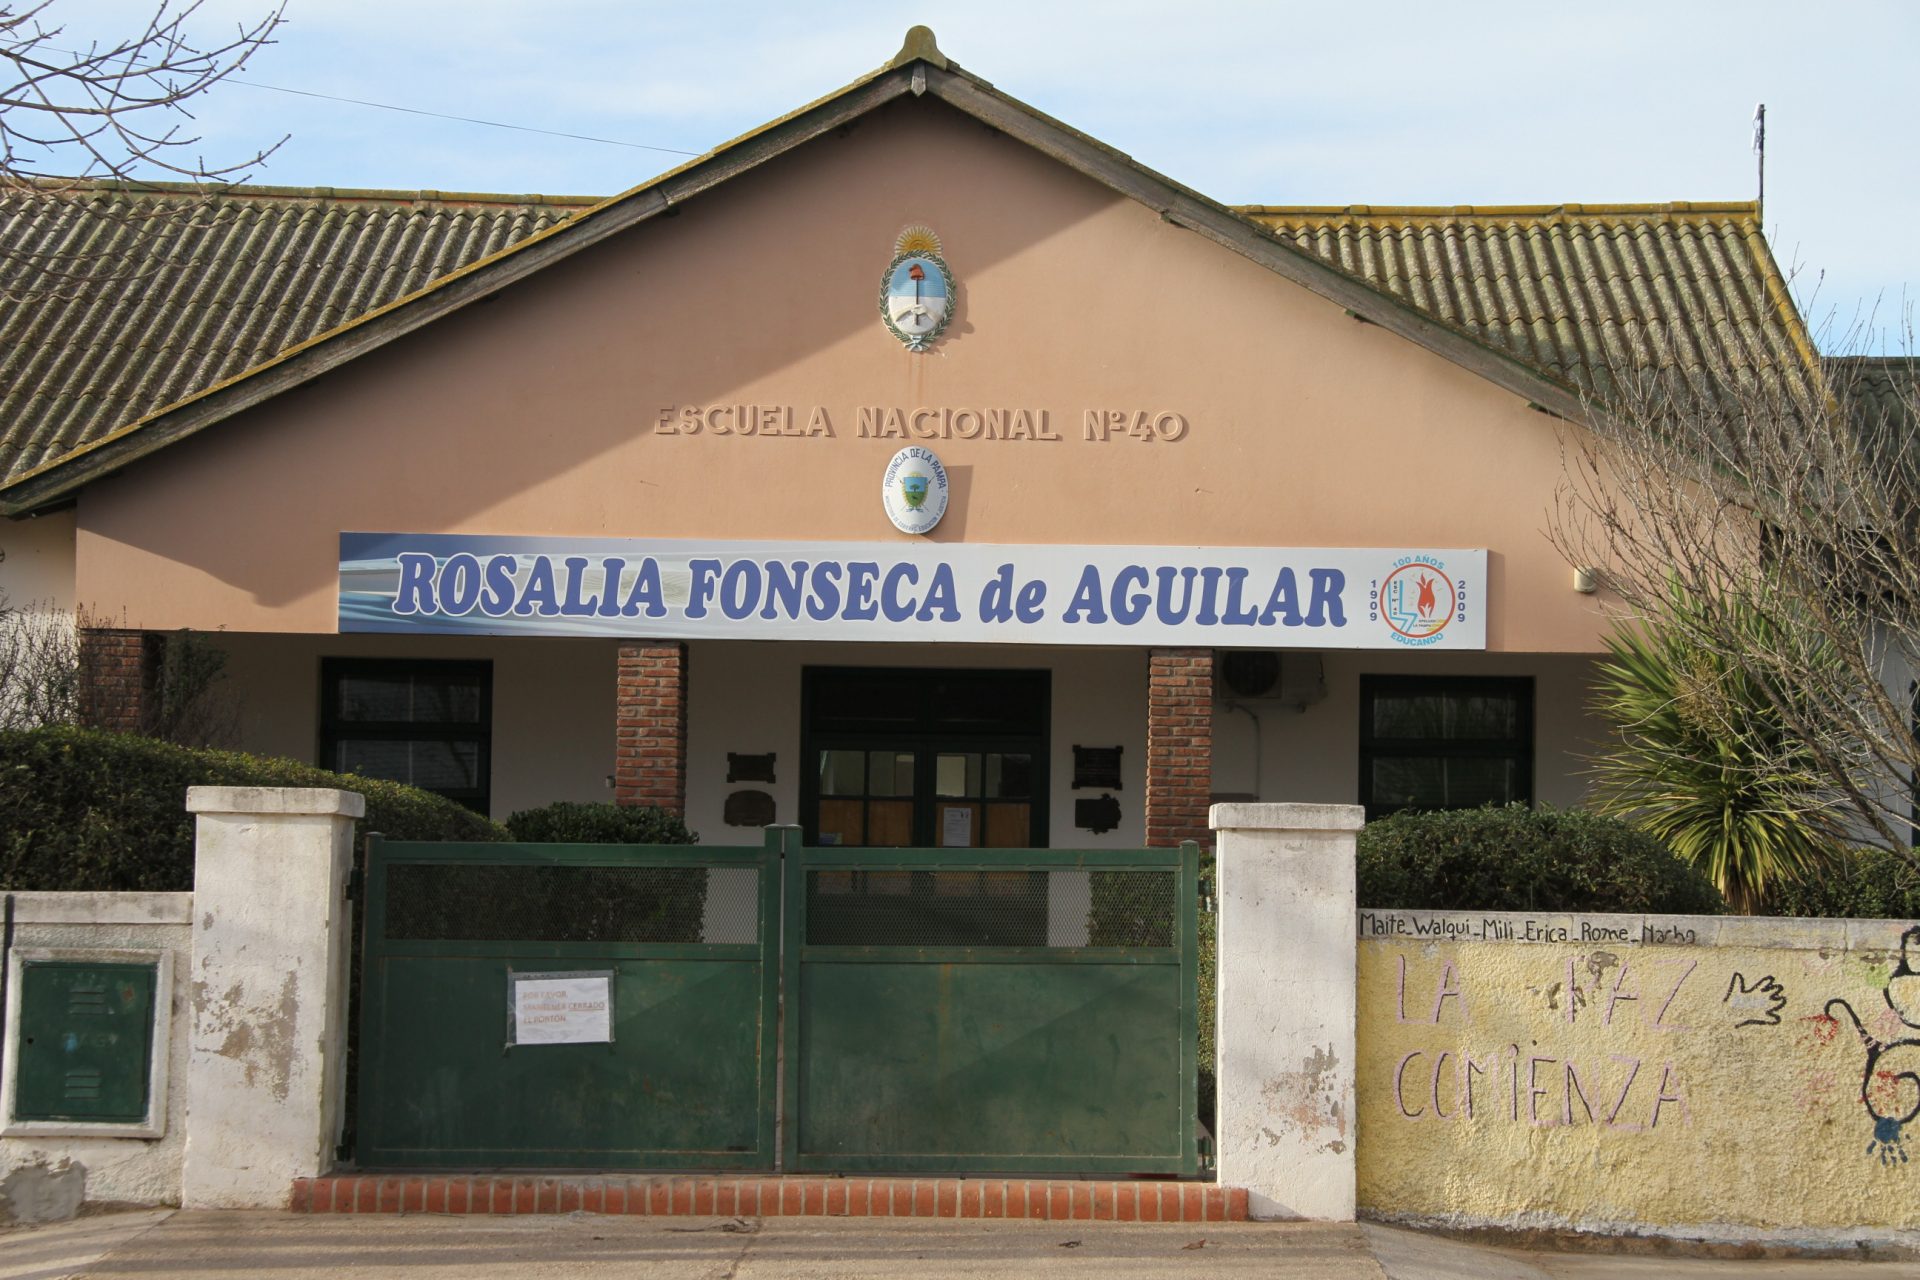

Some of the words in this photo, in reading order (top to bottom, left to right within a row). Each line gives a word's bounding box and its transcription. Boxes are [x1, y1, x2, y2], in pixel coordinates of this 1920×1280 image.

[653, 404, 835, 437] ESCUELA
[856, 406, 1061, 440] NACIONAL
[885, 452, 909, 487] PROVINCIA
[910, 448, 920, 457] DE
[921, 449, 933, 463] LA
[930, 460, 947, 489] PAMPA
[1392, 557, 1412, 568] 100
[1415, 555, 1445, 569] AÑOS
[392, 553, 668, 619] ROSALIA
[683, 557, 961, 624] FONSECA
[979, 563, 1047, 624] de
[1062, 564, 1347, 628] AGUILAR
[1370, 579, 1378, 621] 1909
[1458, 580, 1466, 622] 2009
[1390, 632, 1444, 646] EDUCANDO
[568, 1001, 605, 1010] CERRADO
[1396, 953, 1472, 1026] LA
